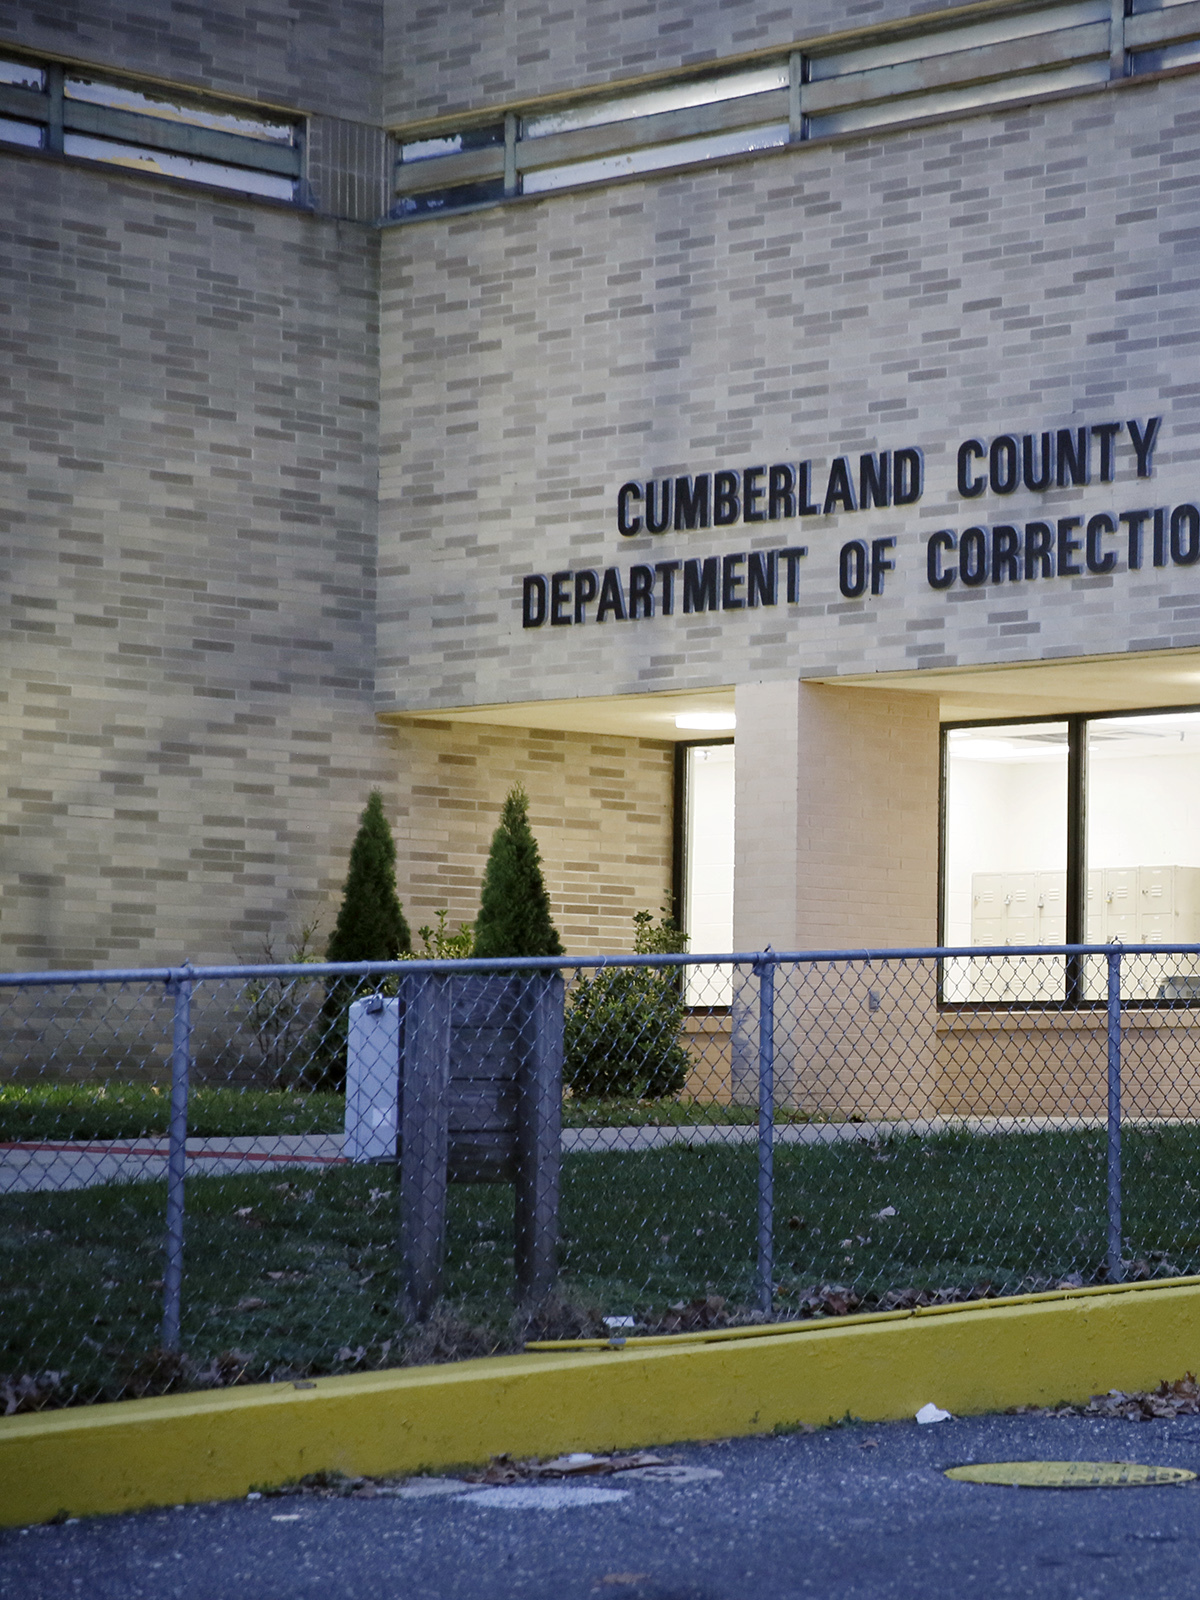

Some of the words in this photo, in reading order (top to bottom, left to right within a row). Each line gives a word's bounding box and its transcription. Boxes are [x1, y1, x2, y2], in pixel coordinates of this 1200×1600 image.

[618, 447, 923, 537] CUMBERLAND
[957, 417, 1161, 498] COUNTY
[522, 546, 807, 628] DEPARTMENT
[839, 538, 896, 598] OF
